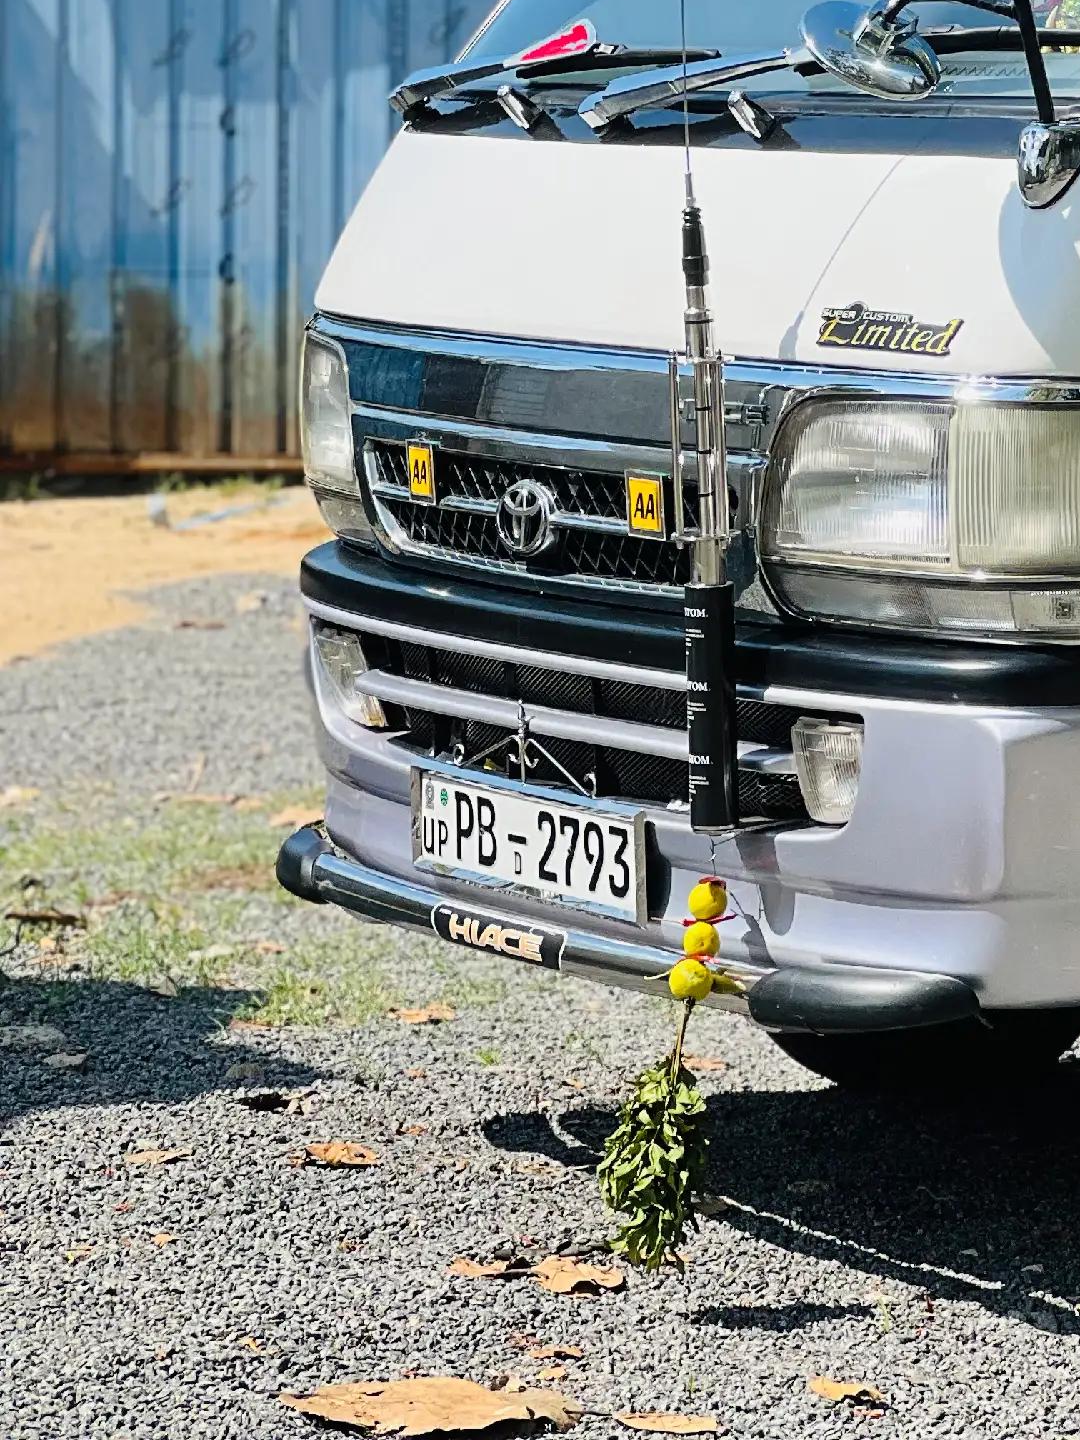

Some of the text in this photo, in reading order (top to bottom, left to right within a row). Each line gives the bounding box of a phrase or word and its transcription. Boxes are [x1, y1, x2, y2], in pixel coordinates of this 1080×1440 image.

[821, 308, 910, 323] SUPER CUSTOM
[818, 319, 965, 353] Limited
[412, 459, 427, 485] AA
[633, 492, 655, 520] AA
[423, 816, 448, 856] UP
[449, 913, 543, 962] HIACE
